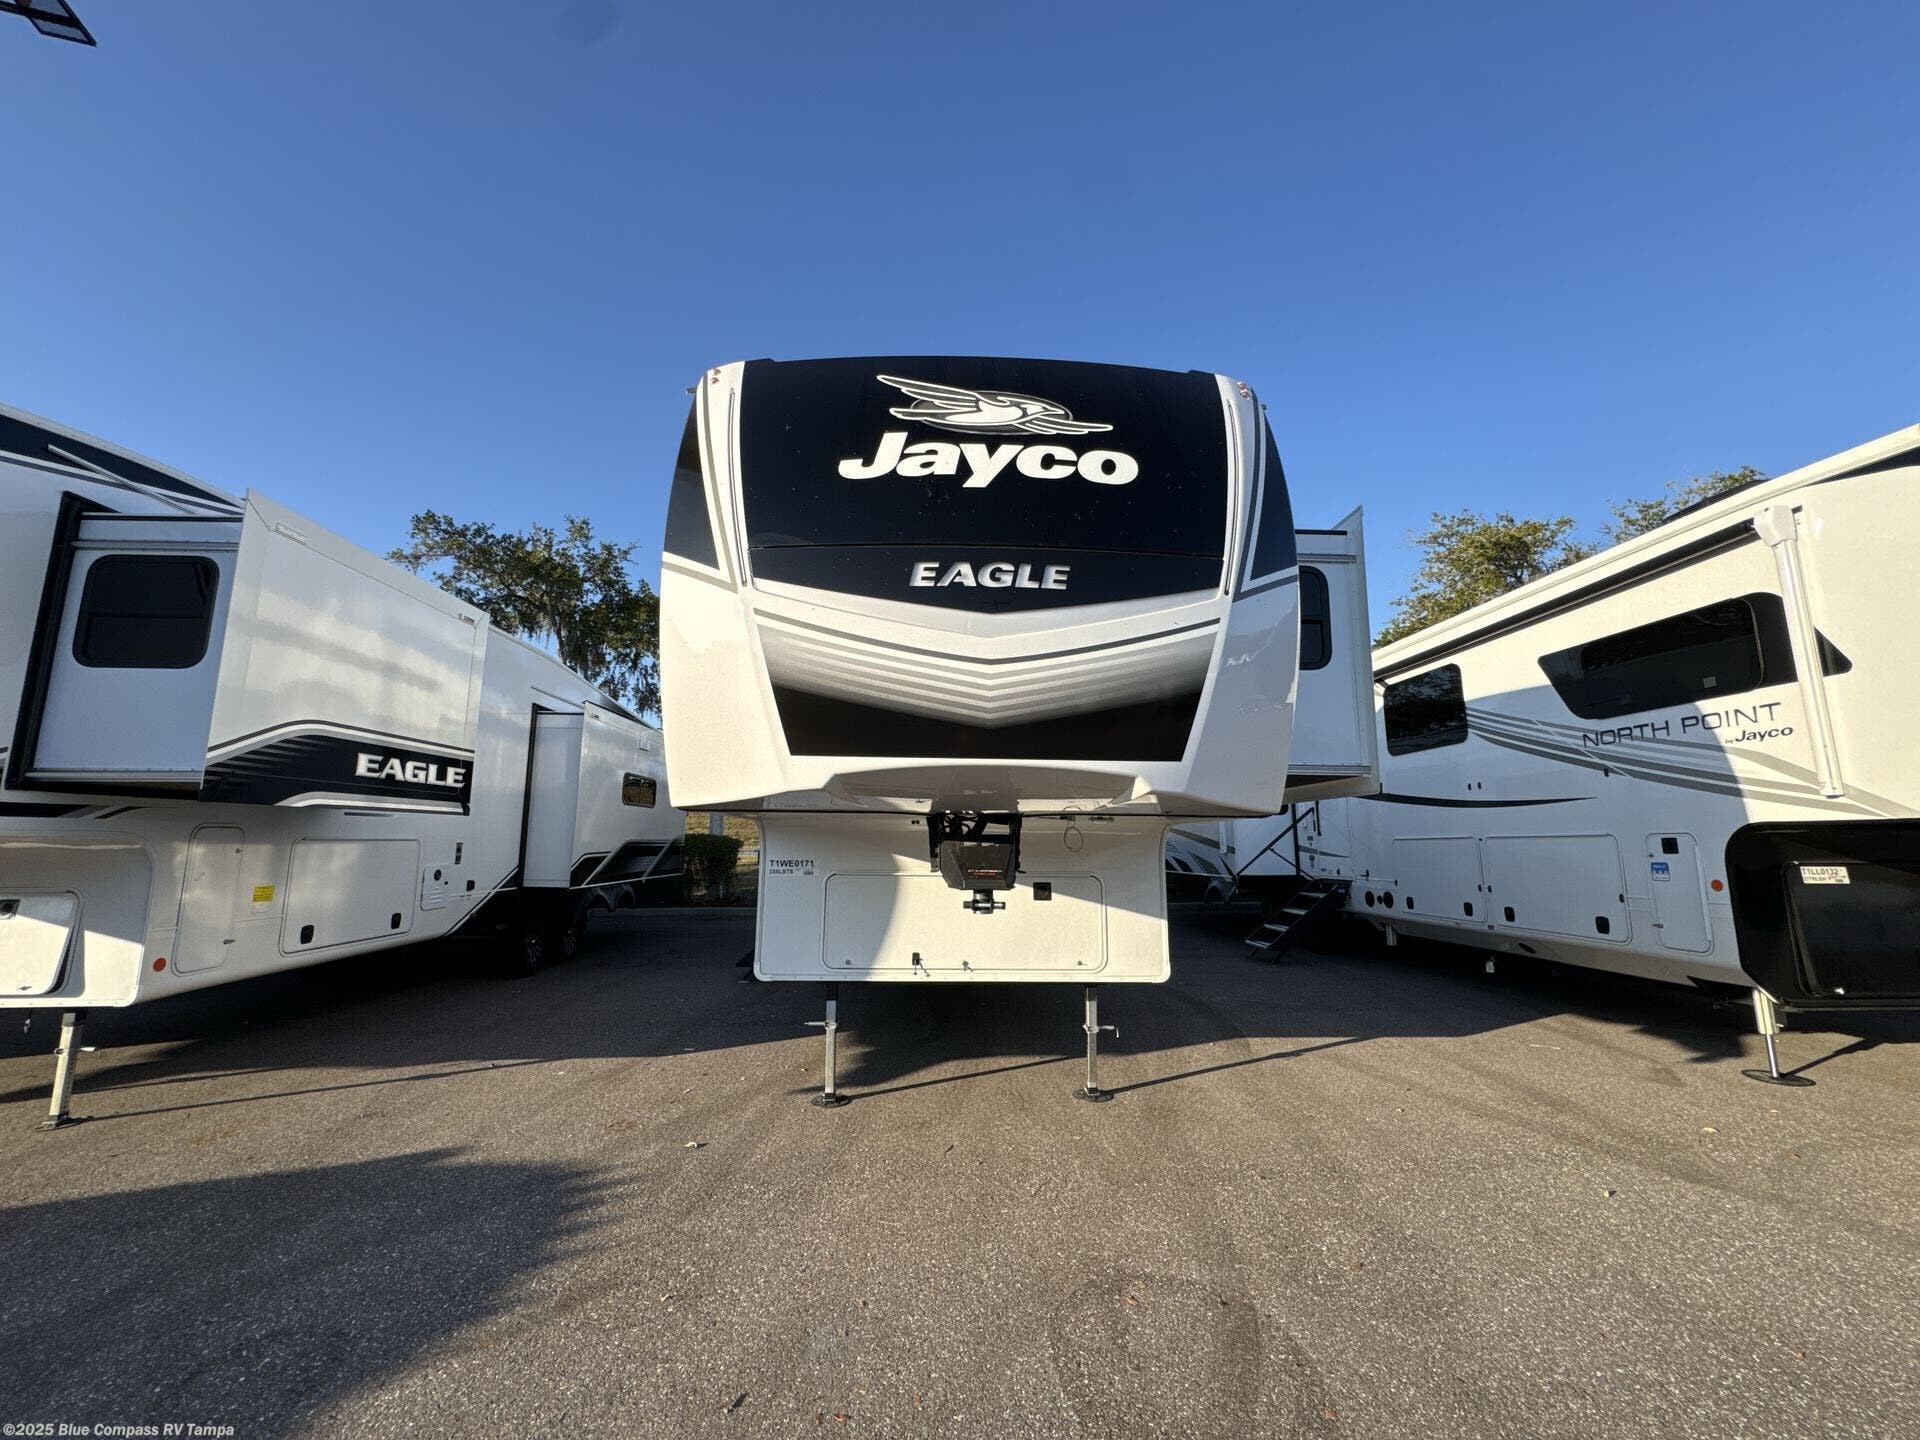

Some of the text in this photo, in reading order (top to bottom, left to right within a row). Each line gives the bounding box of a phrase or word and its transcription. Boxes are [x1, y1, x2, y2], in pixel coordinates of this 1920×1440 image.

[837, 431, 1139, 488] Jayco
[908, 561, 1071, 590] EAGLE
[1582, 702, 1781, 748] NORTH POINT
[1734, 726, 1794, 743] Jayco
[355, 752, 466, 788] EAGLE
[769, 859, 814, 867] T1WE0171
